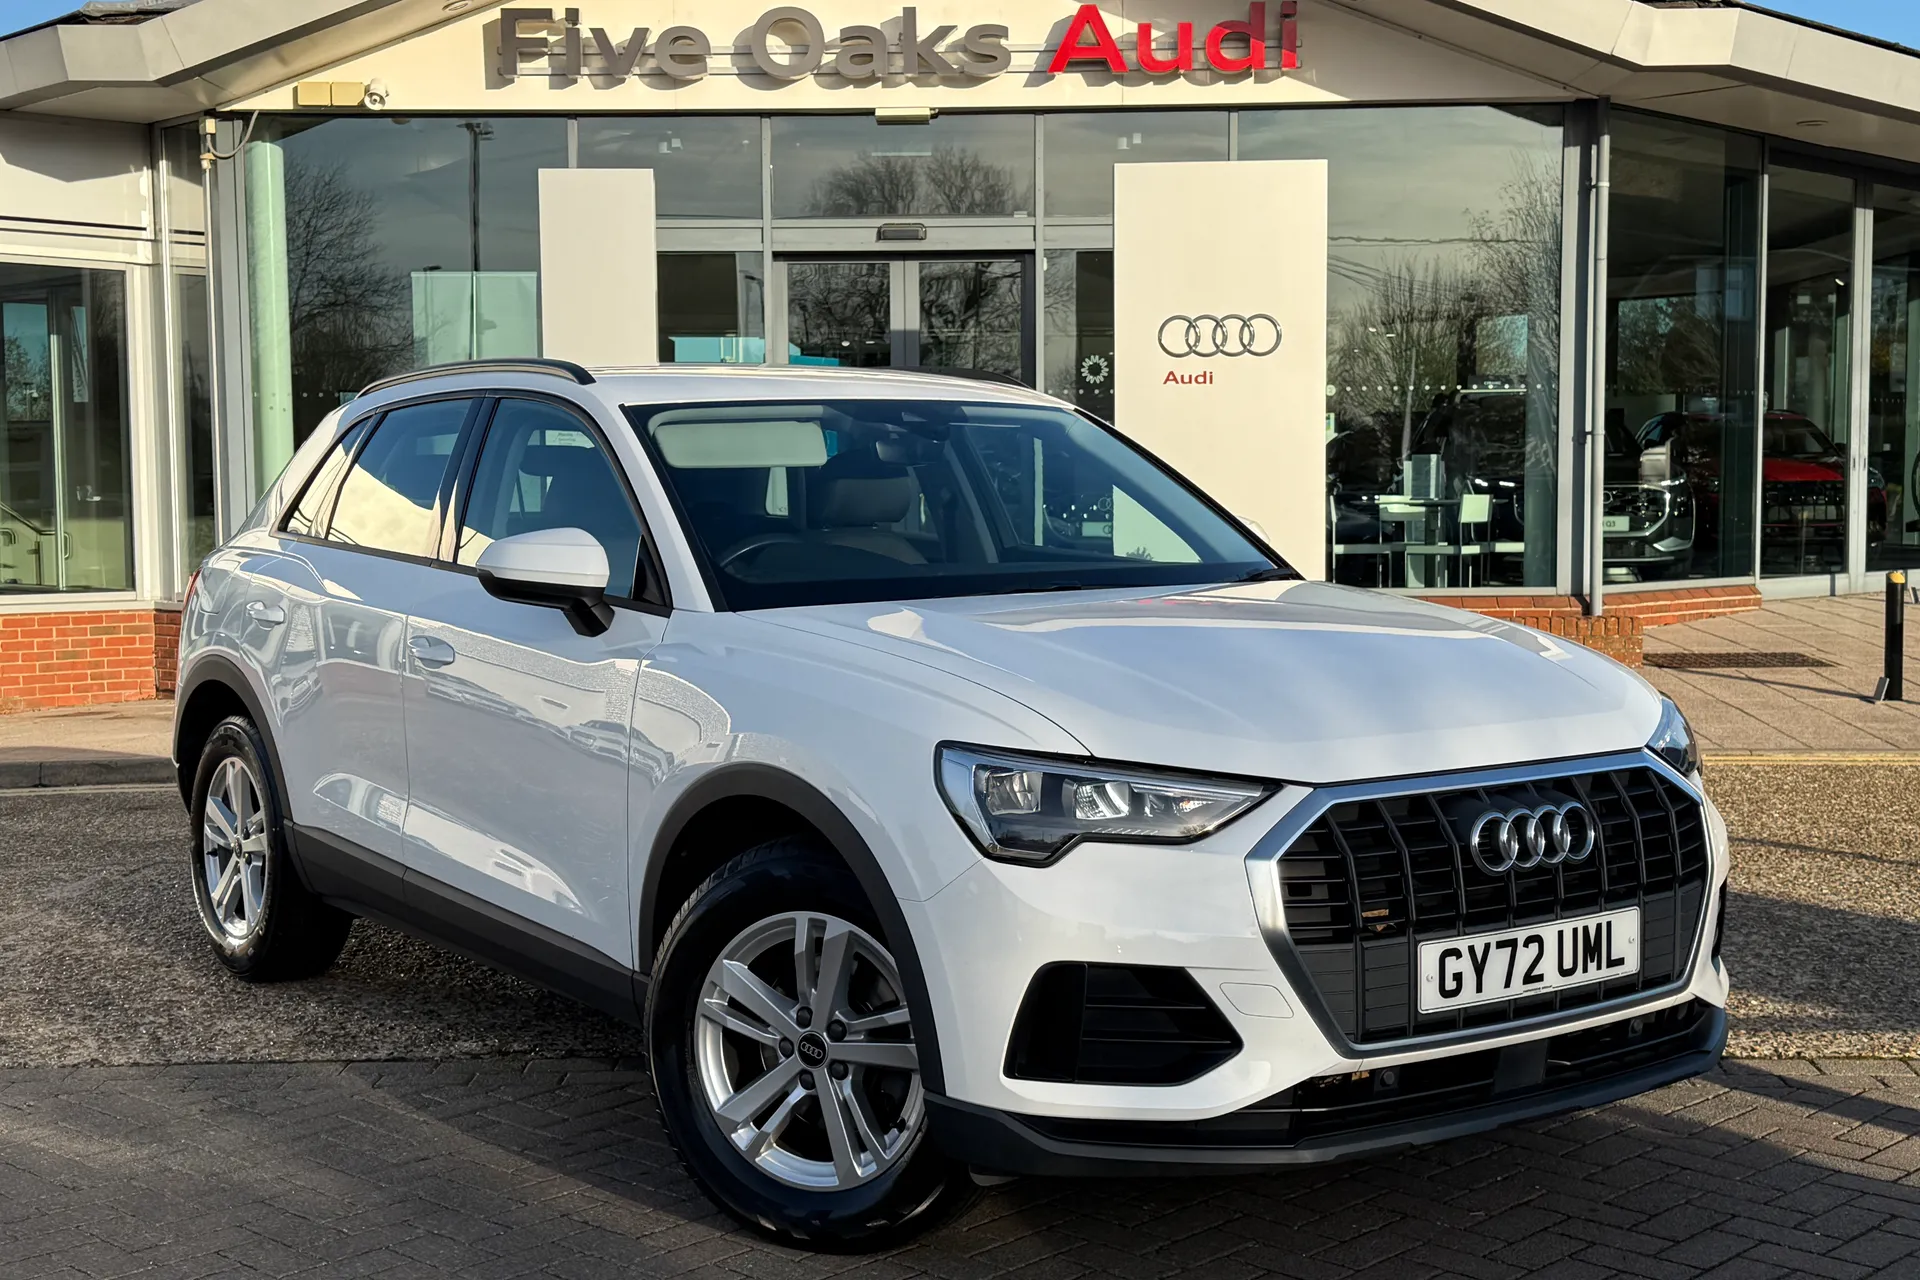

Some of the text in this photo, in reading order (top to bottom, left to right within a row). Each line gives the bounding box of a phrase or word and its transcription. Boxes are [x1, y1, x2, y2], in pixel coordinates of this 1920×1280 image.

[501, 1, 1297, 79] Five Oaks Audi
[1163, 371, 1213, 384] Audi
[1605, 520, 1616, 528] Q3
[1438, 921, 1625, 999] GY72 UML
